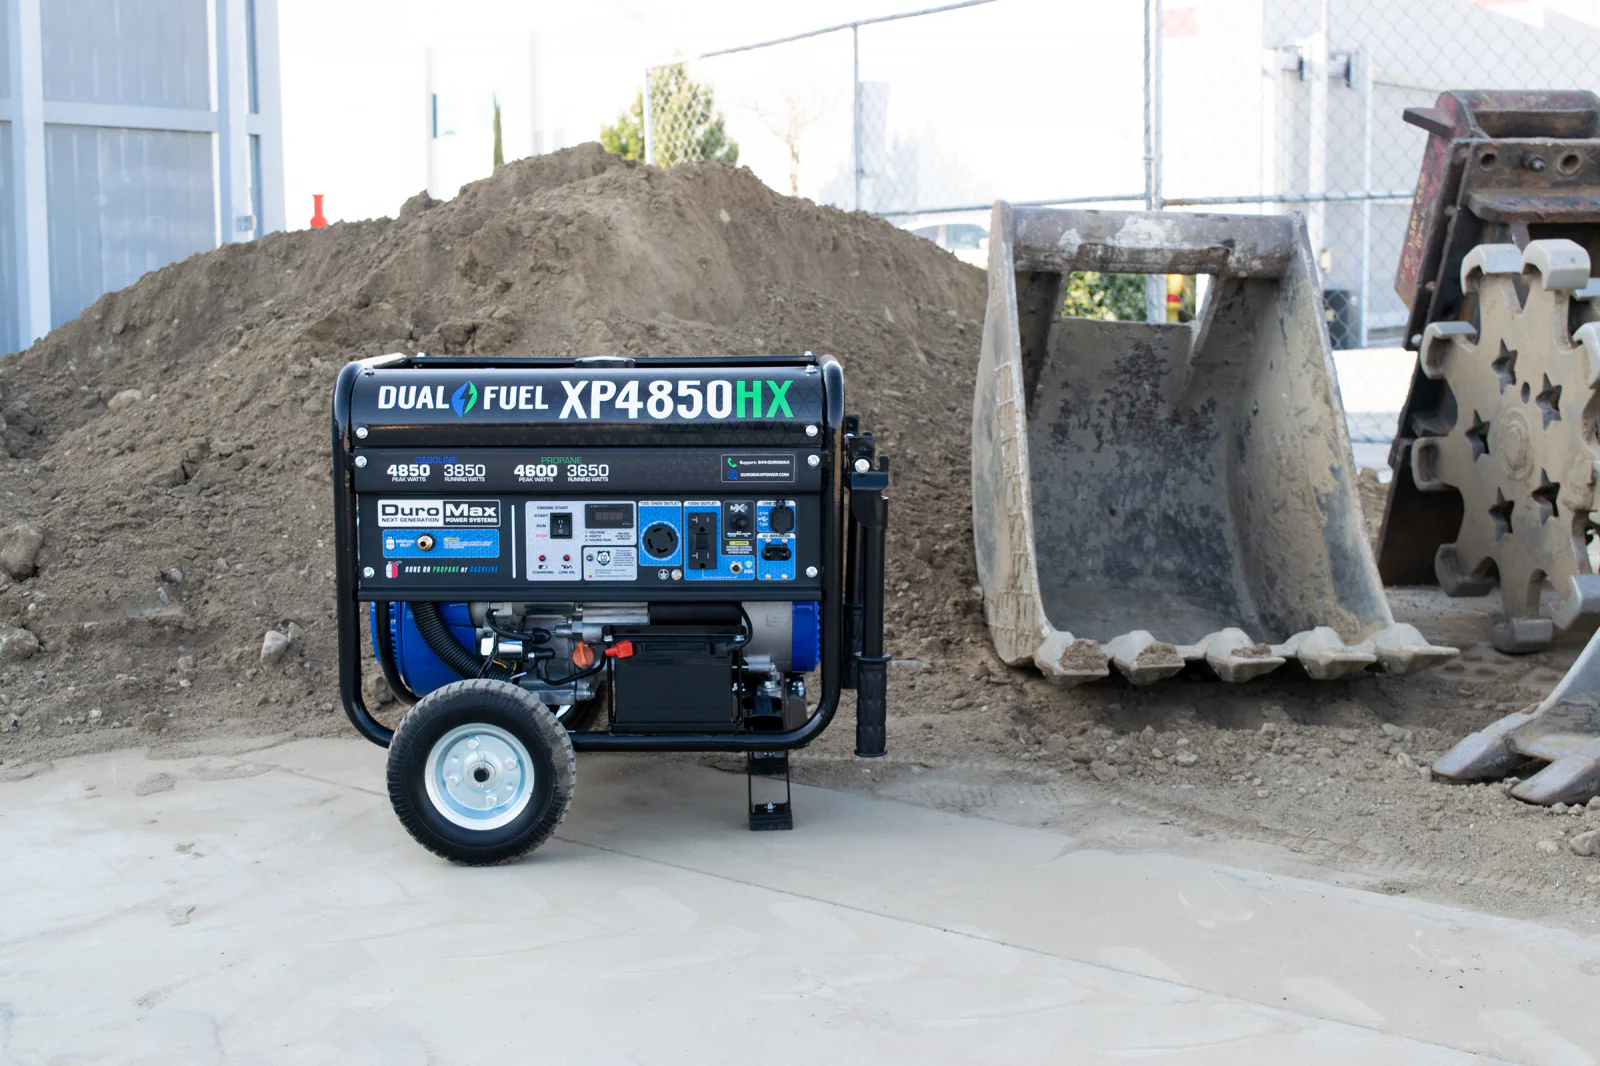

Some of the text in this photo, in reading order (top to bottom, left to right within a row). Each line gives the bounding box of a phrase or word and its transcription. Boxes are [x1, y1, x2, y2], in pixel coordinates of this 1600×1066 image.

[378, 379, 794, 419] DUAL FUEL XP4850HX
[415, 456, 458, 465] GASOLINE
[541, 456, 582, 465] PROPANE
[386, 464, 486, 477] 4850 3850
[513, 464, 609, 477] 4600 3650
[381, 503, 497, 517] Duro Max
[404, 565, 421, 573] RUNS
[422, 565, 431, 573] ON
[432, 565, 459, 573] PROPANE
[469, 565, 499, 573] GASOLINE
